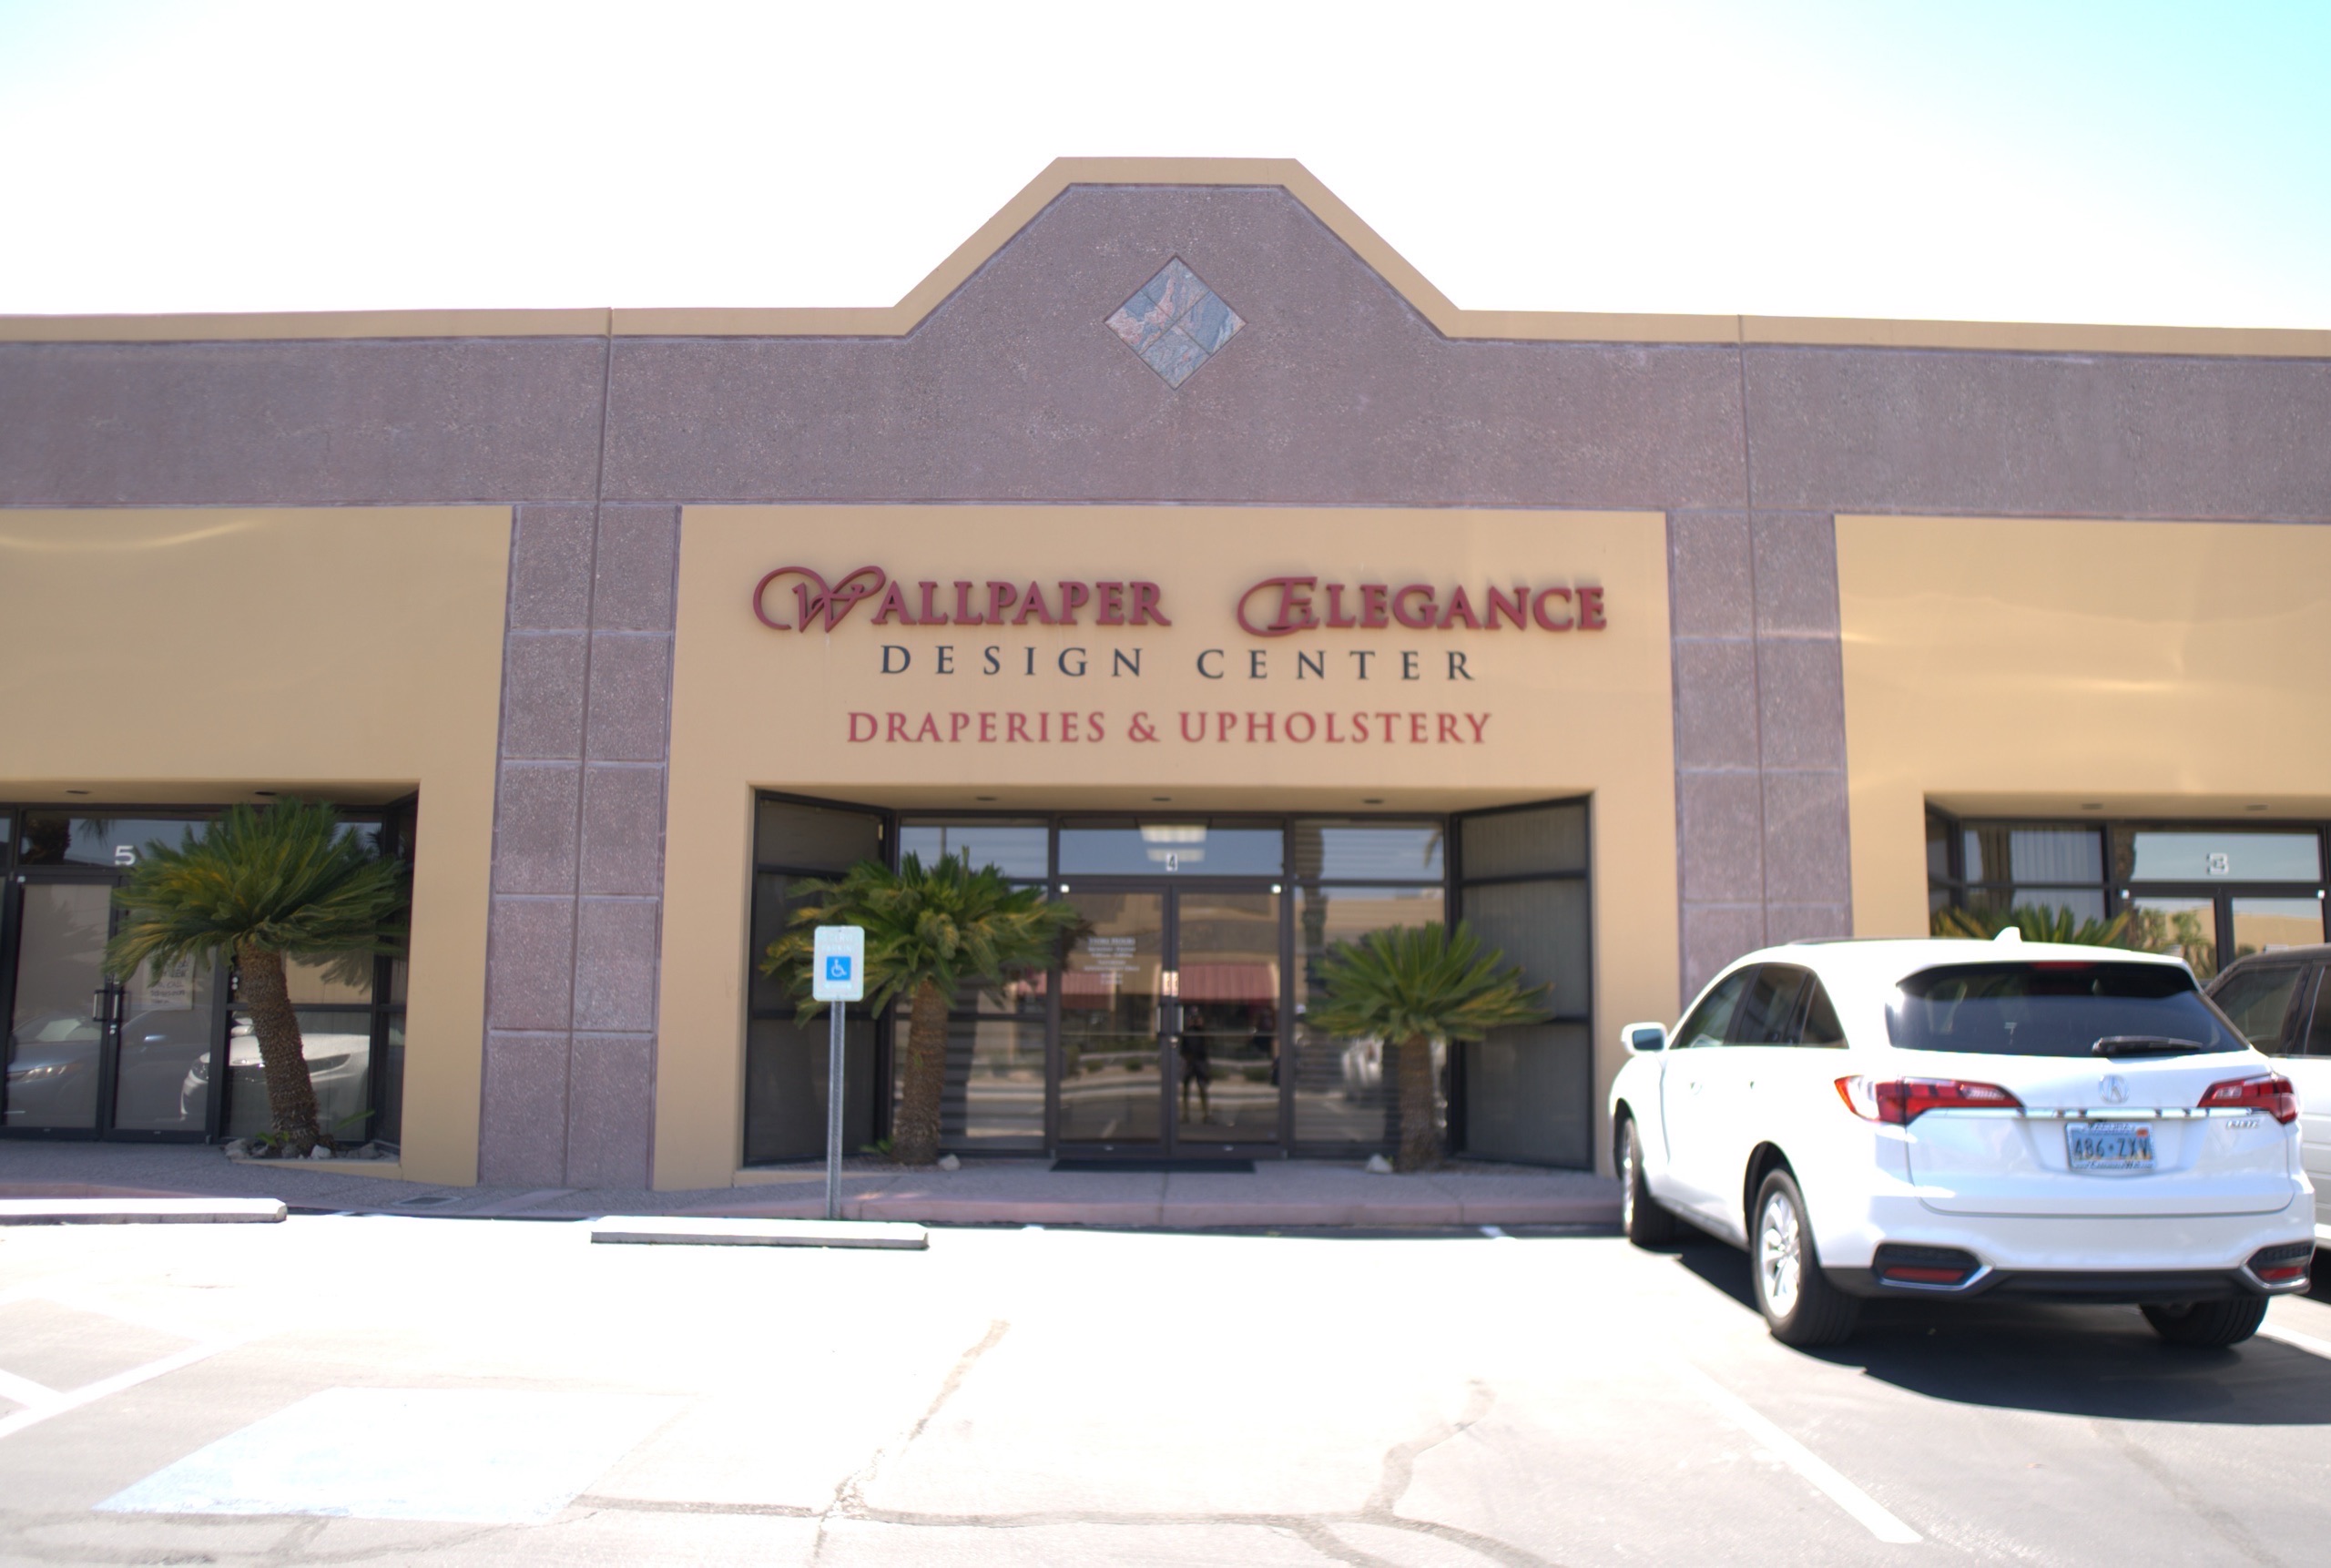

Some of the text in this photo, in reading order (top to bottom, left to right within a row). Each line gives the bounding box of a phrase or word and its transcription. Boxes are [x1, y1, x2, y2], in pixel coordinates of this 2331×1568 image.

[753, 565, 1607, 637] WALLPAPER ELEGANCE
[880, 645, 1475, 680] DESIGN CENTER
[847, 712, 1492, 743] DRAPERIES & UPHOLSTERY
[115, 845, 136, 866] 5
